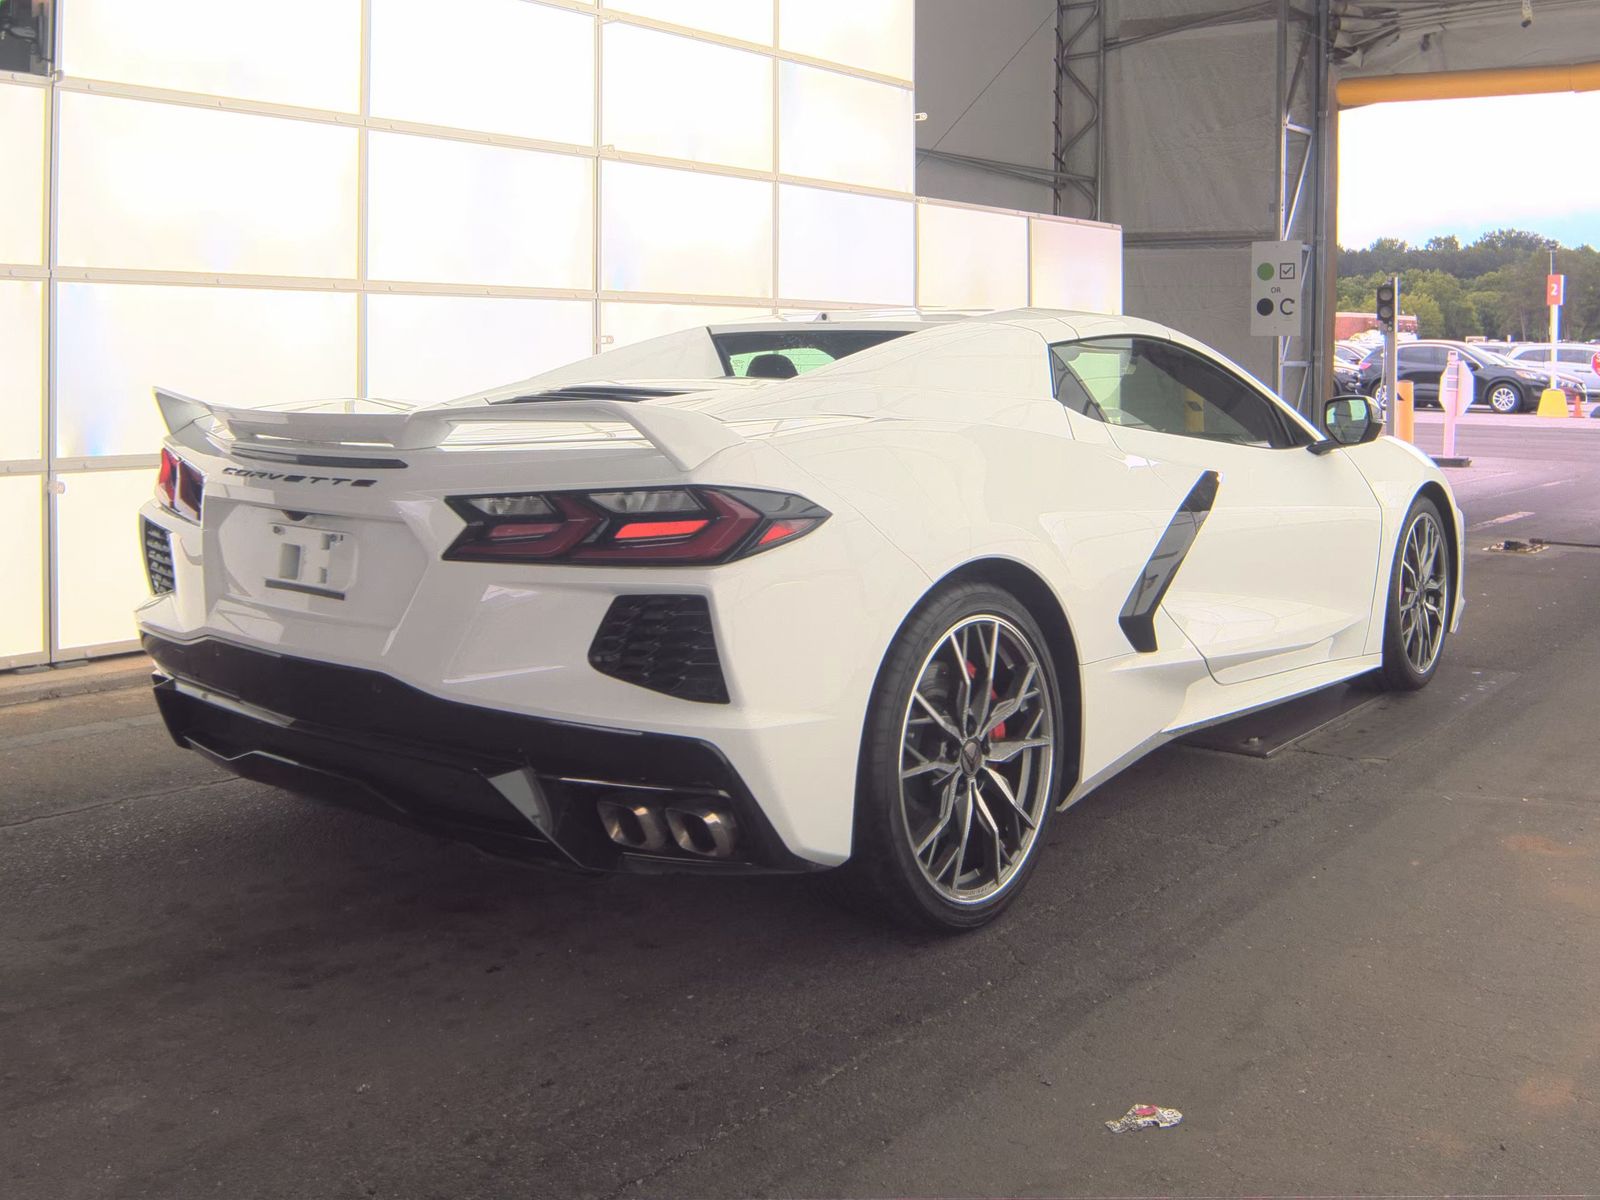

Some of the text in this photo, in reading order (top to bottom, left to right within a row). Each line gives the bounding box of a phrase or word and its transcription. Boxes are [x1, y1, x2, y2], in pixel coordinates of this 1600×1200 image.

[1270, 286, 1281, 294] OR
[1551, 283, 1559, 296] 2
[222, 467, 377, 487] CORVETTE
